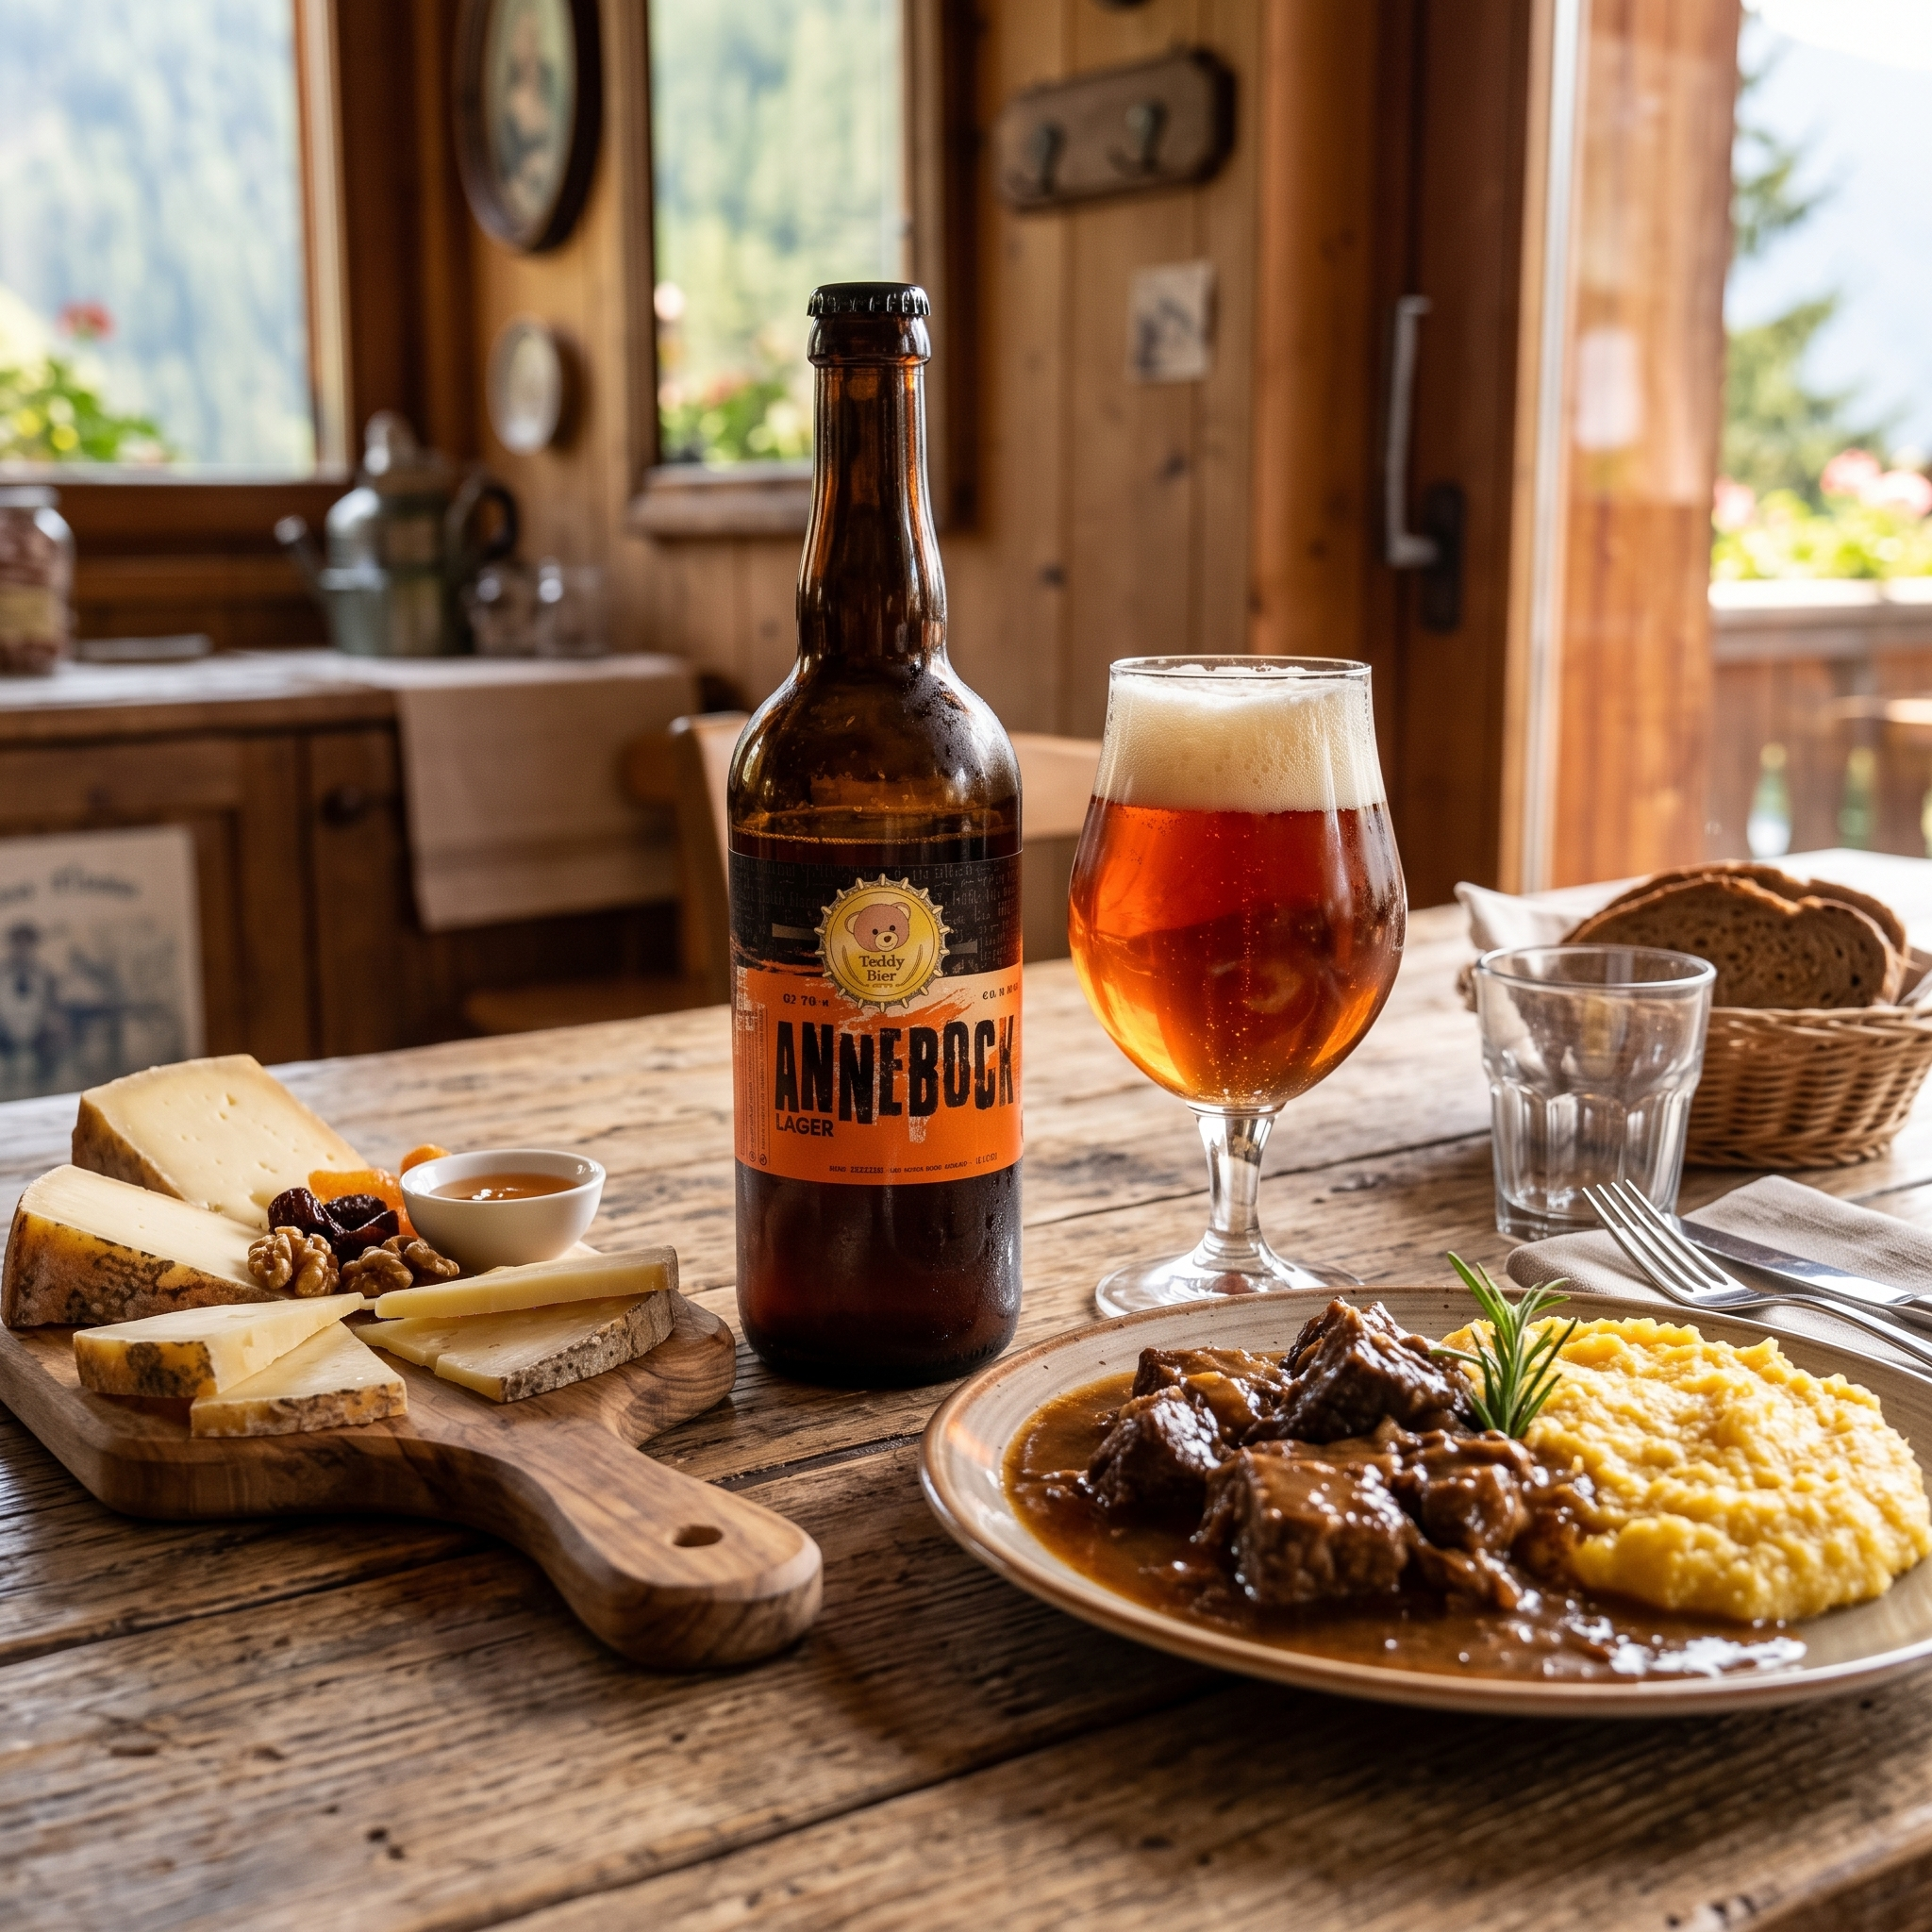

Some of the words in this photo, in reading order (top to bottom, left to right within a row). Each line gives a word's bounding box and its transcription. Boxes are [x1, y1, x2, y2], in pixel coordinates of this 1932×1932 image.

[858, 955, 906, 970] Teddy
[866, 969, 897, 982] Bier
[774, 1014, 1014, 1125] ANNEBOCK
[775, 1112, 834, 1138] LAGER
